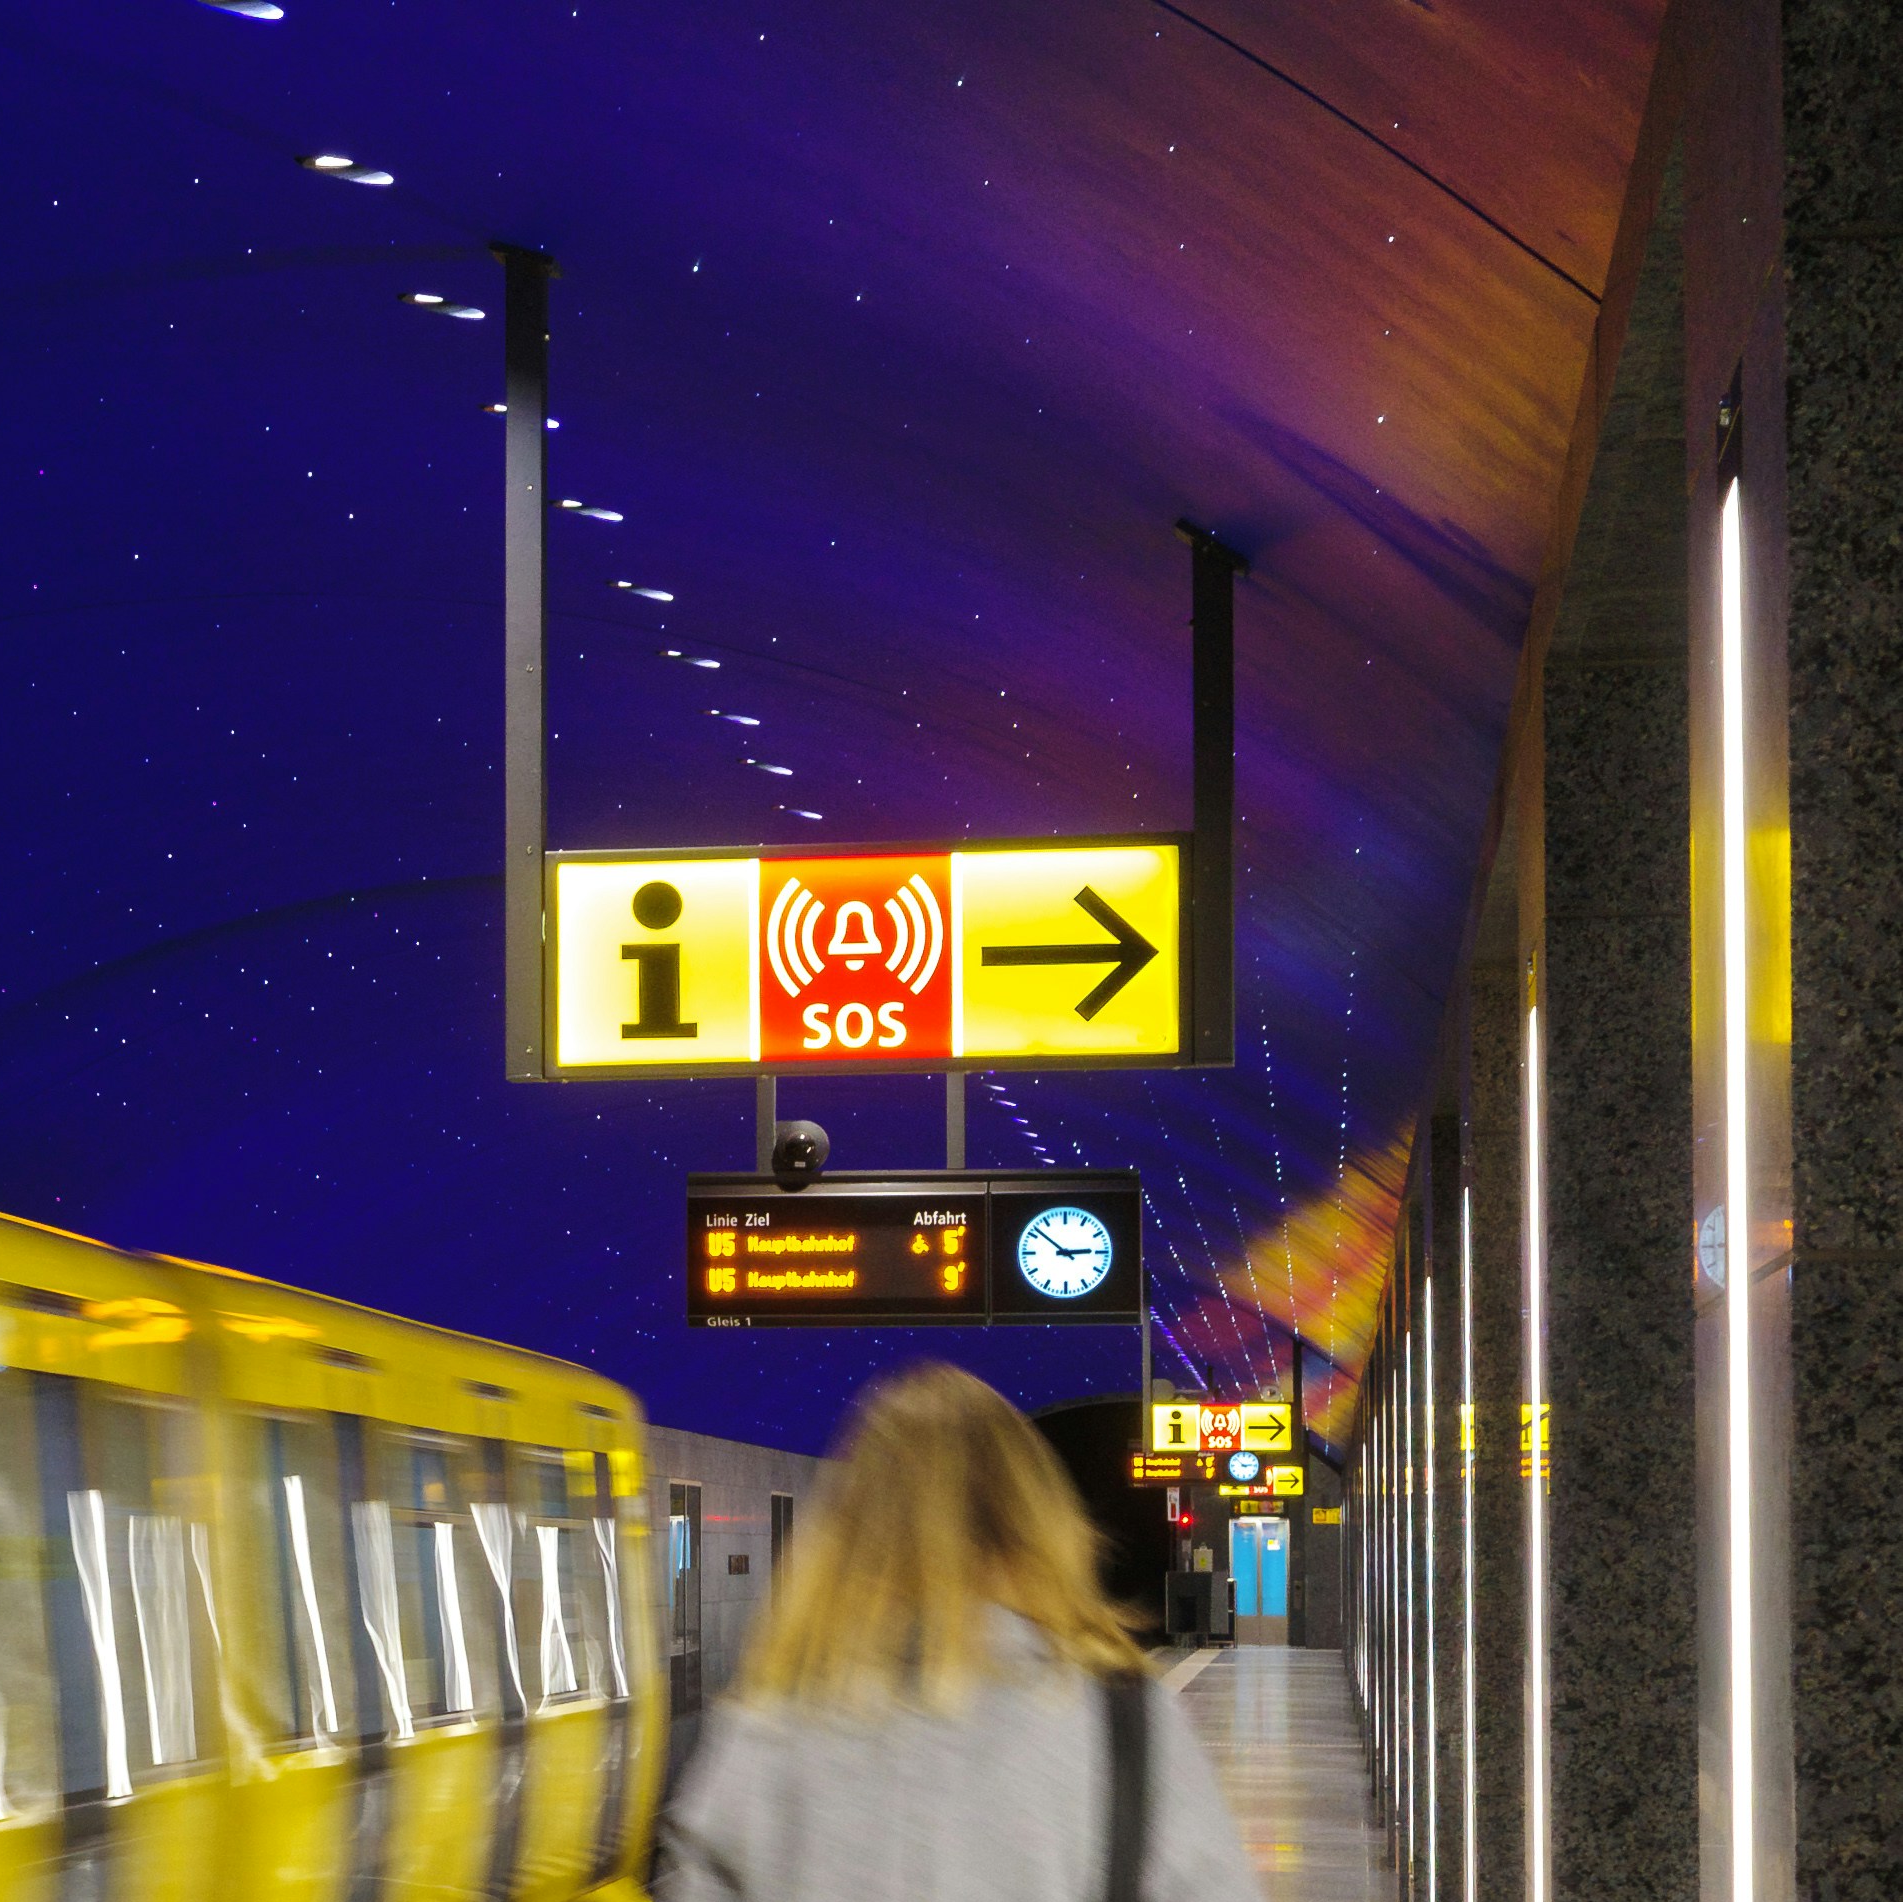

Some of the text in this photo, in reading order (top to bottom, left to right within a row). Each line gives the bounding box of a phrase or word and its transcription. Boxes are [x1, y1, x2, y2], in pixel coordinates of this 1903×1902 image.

[802, 1001, 907, 1050] SOS
[706, 1212, 770, 1227] Linie Ziel
[913, 1210, 967, 1226] Abfahrt
[708, 1232, 736, 1257] U5
[747, 1234, 855, 1255] Hauptbahnhof
[708, 1267, 736, 1293] U5
[747, 1270, 855, 1291] Hauptbahnhof
[706, 1316, 752, 1328] Gleis 1
[1208, 1435, 1233, 1449] SOS
